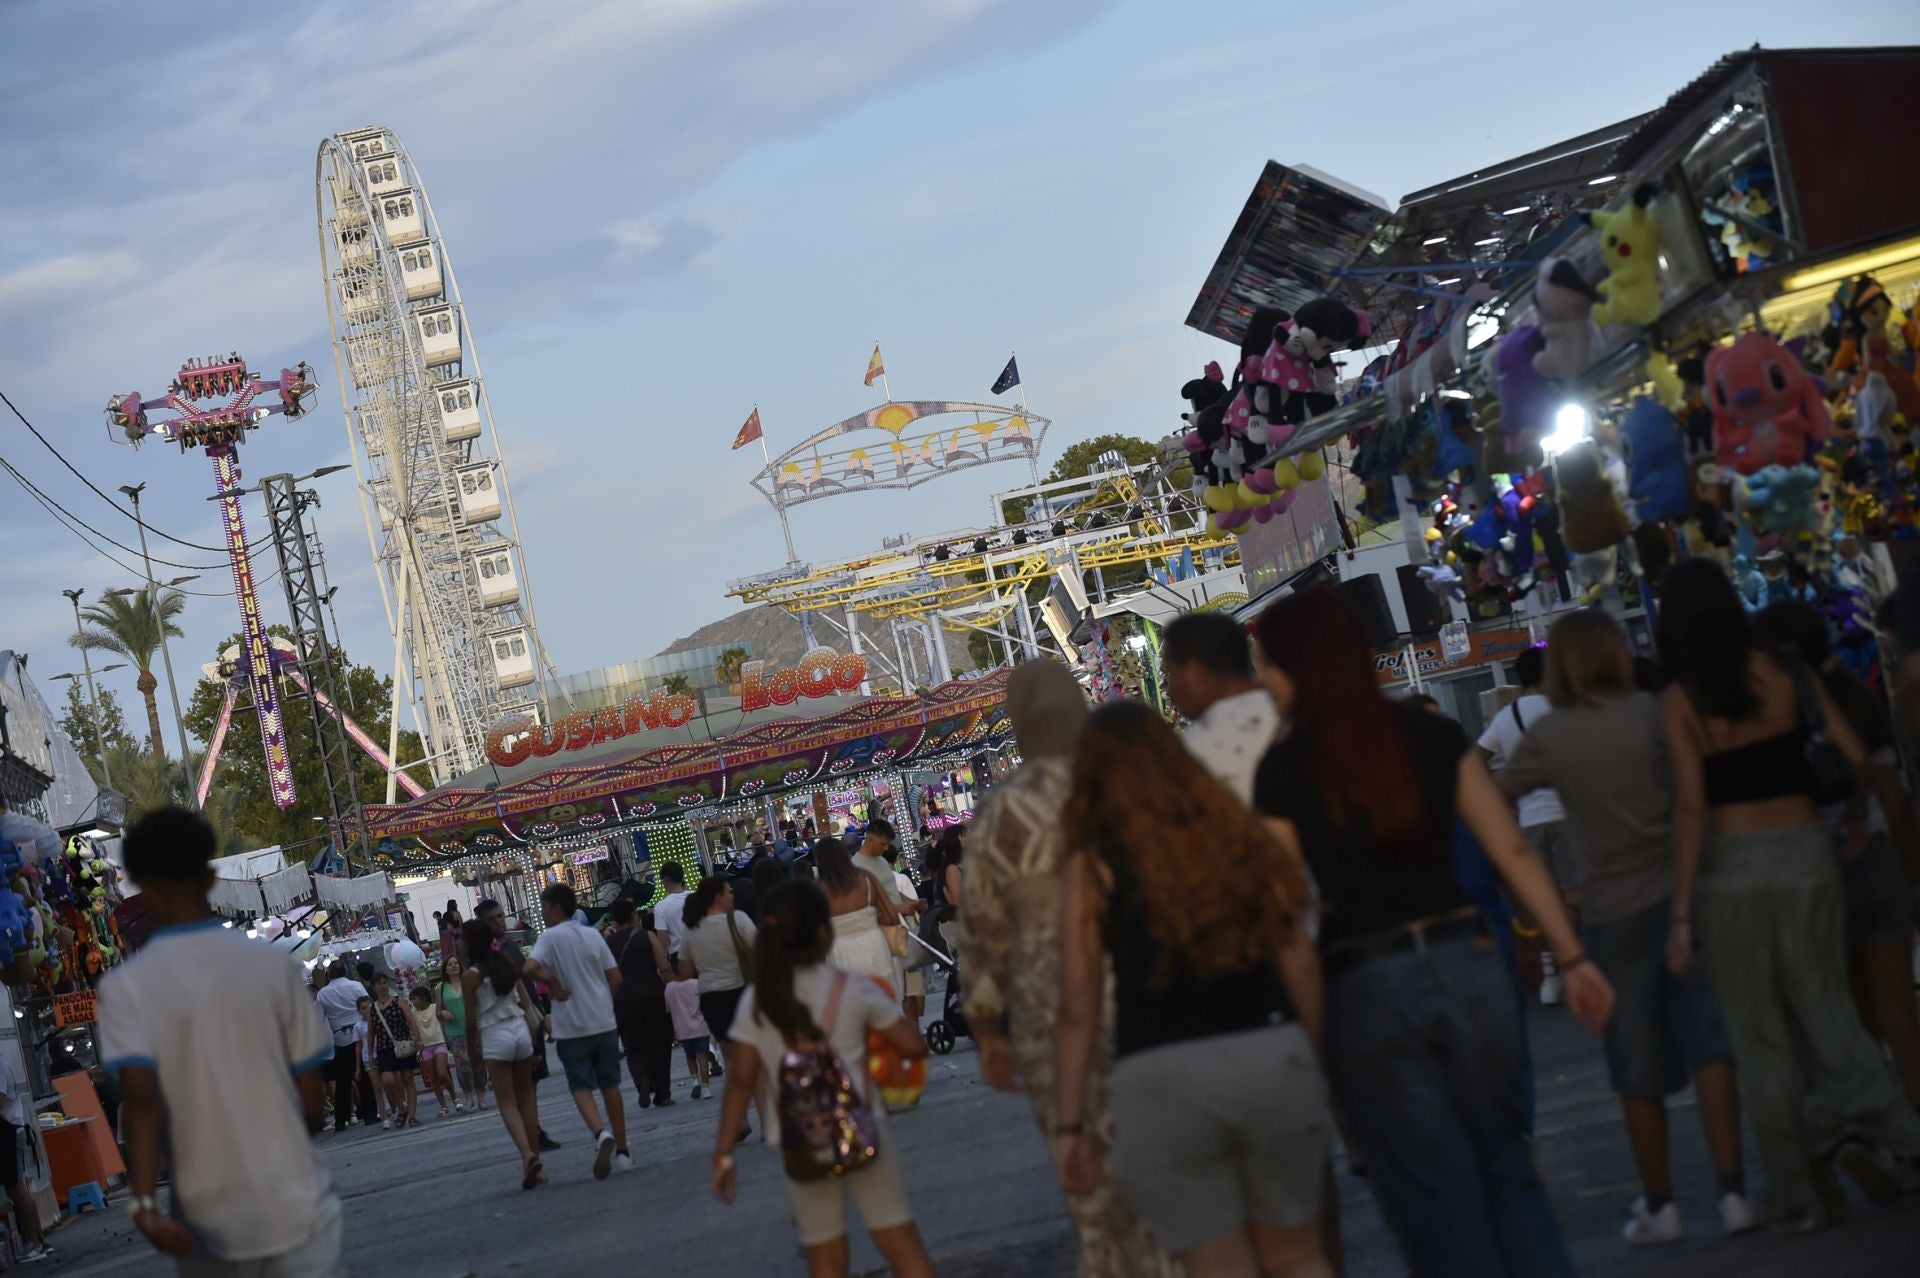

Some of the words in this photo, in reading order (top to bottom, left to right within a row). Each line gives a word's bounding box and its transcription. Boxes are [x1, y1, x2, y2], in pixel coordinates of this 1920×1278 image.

[484, 686, 696, 768] GUSANO
[741, 645, 867, 712] LOCO
[844, 724, 885, 739] GUSANO
[894, 715, 920, 727] LOCO
[474, 811, 496, 819] LOCO
[54, 991, 96, 1006] PANOCHAS
[61, 1005, 71, 1015] DE
[73, 1002, 93, 1012] MAIZ
[64, 1012, 95, 1025] ASADAS
